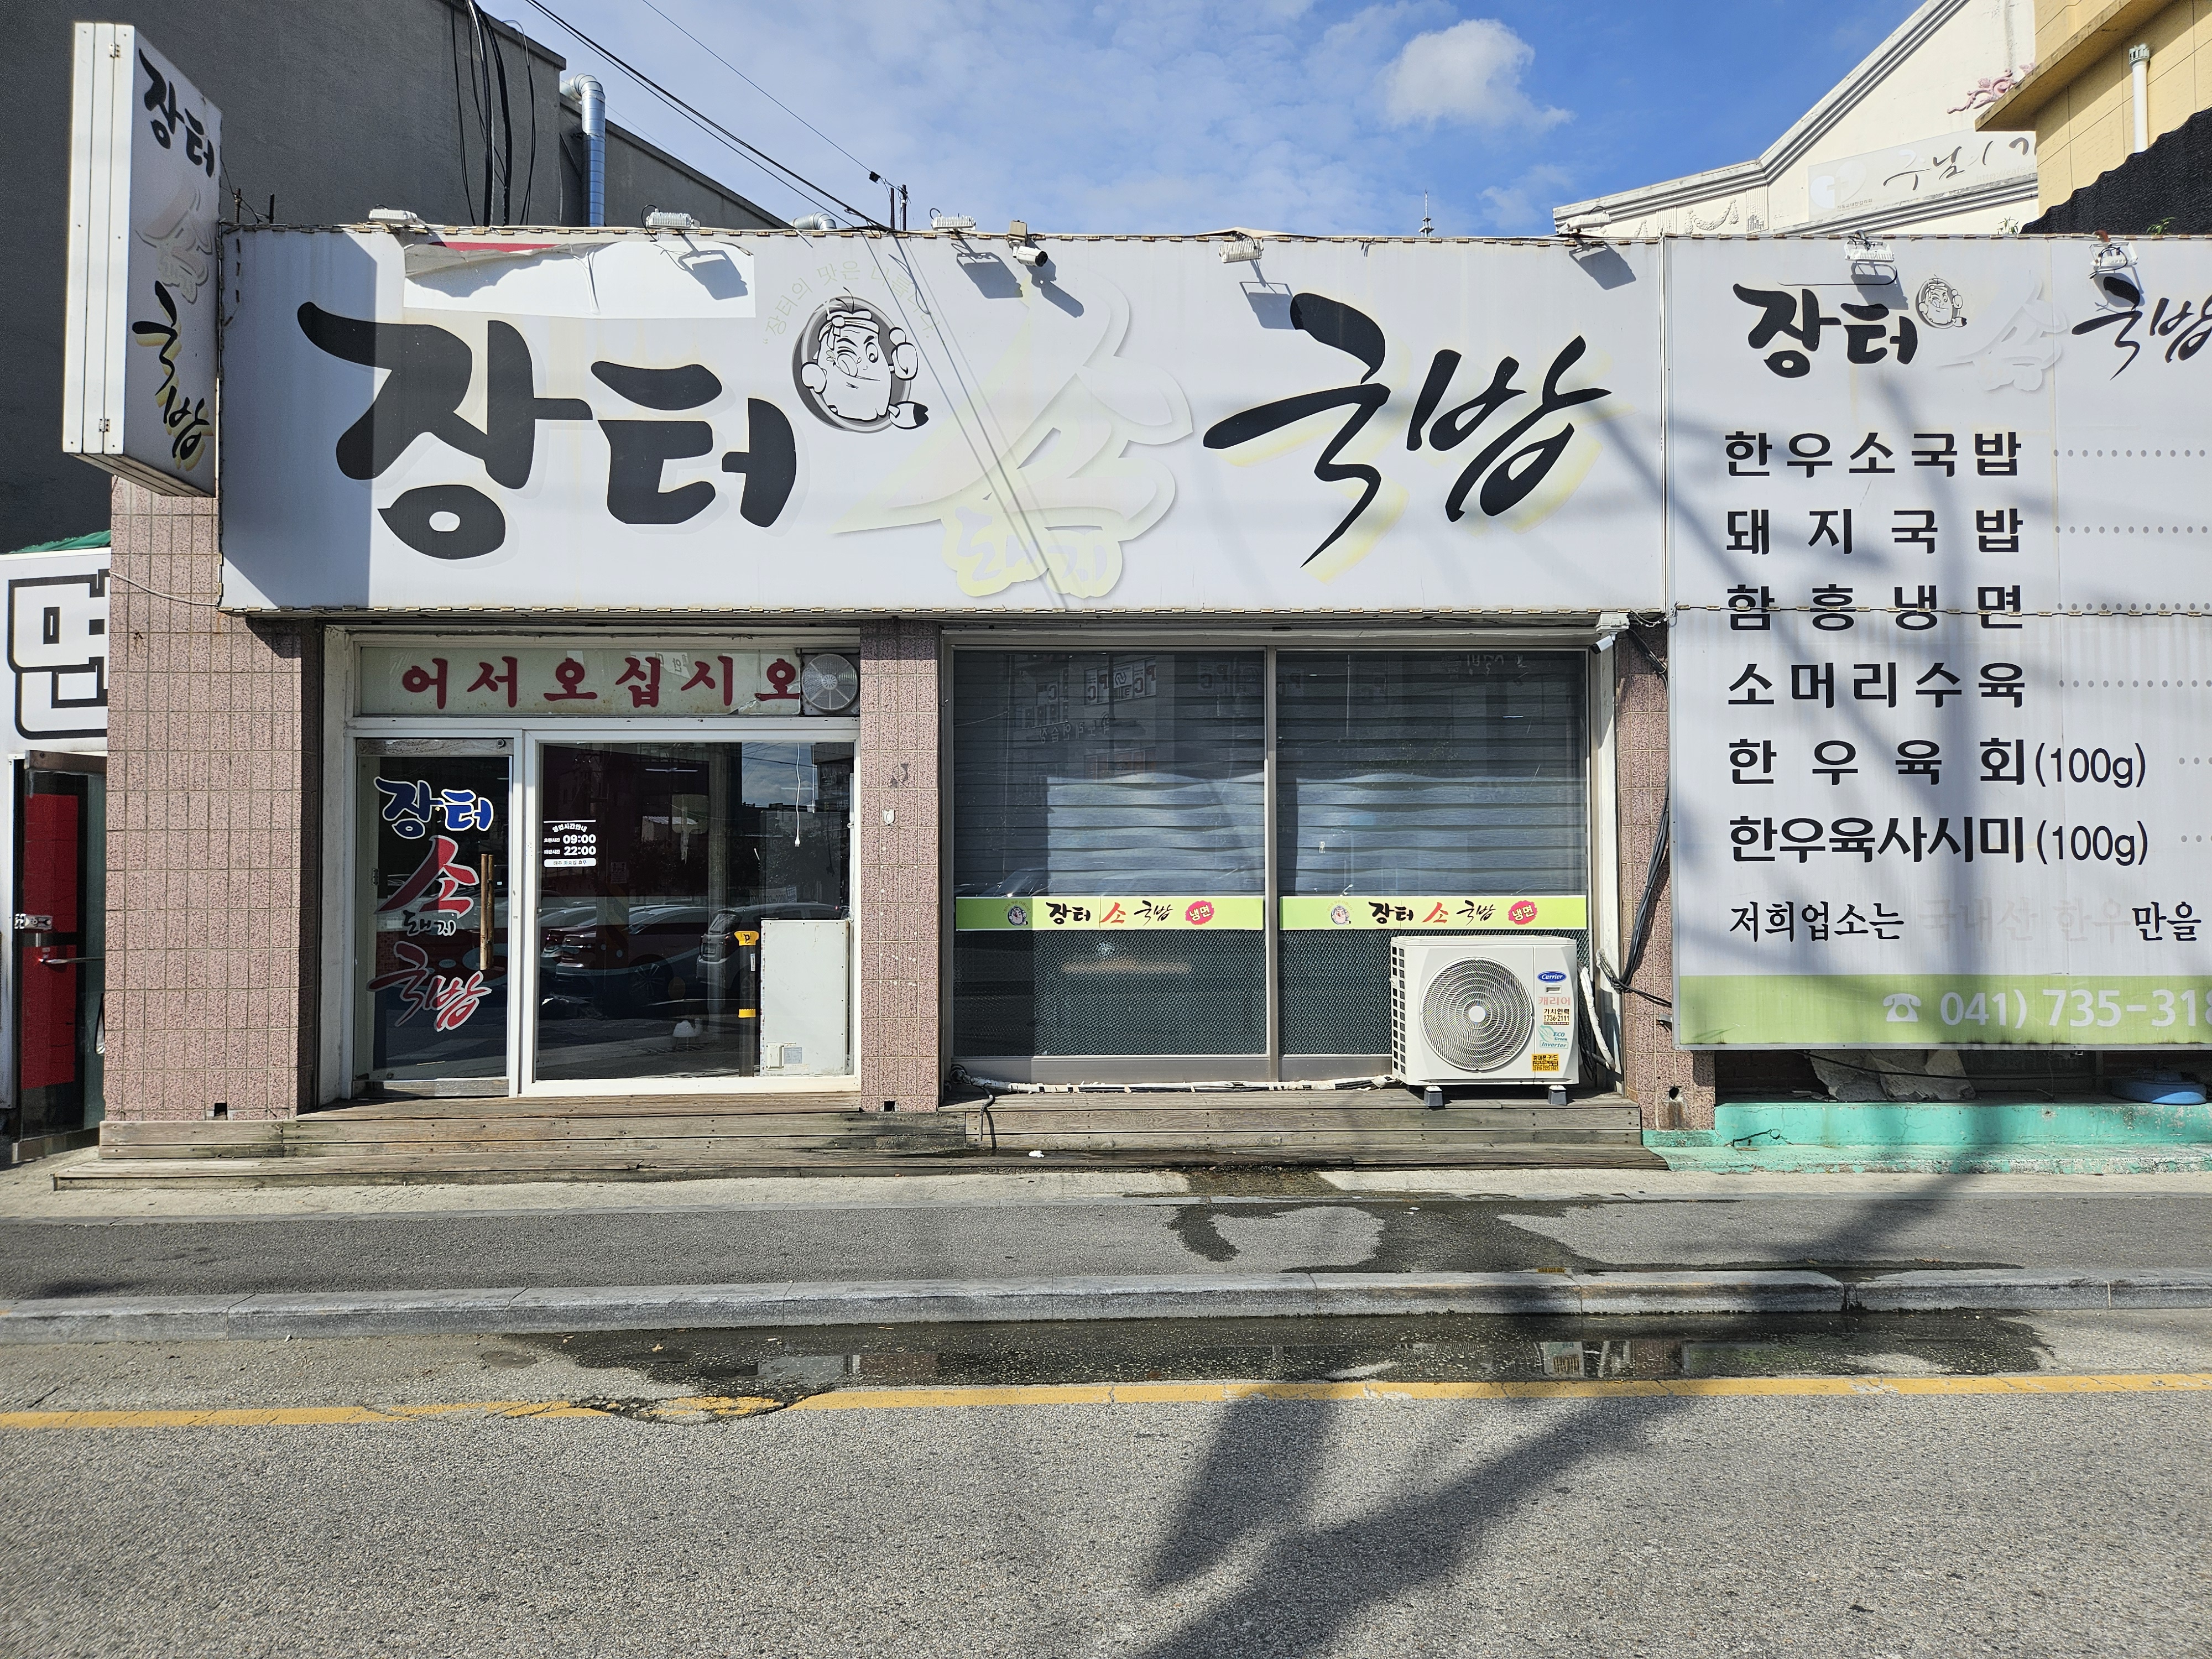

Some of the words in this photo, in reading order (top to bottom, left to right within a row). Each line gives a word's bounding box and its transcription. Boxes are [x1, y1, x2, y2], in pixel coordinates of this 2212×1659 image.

[138, 48, 215, 178] 장터
[1732, 283, 1919, 378] 장터
[2072, 276, 2212, 381] 국밥
[133, 280, 211, 460] 국밥
[297, 301, 797, 560] 장터
[1203, 293, 1613, 568] 국밥
[1725, 431, 2022, 477] 한우소국밥
[1728, 662, 2025, 708] 소머리수육
[374, 776, 494, 839] 장터
[562, 834, 597, 844] 09:00
[564, 846, 597, 856] 22:00
[373, 834, 480, 919] 소
[1045, 901, 1091, 925] 장터
[1099, 902, 1126, 924] 소
[1134, 900, 1173, 927] 국밥
[1188, 904, 1212, 921] 냉면
[1368, 901, 1414, 925] 장터
[1421, 902, 1449, 924] 소
[1455, 899, 1496, 926] 국밥
[1511, 904, 1535, 921] 냉면
[1729, 901, 1905, 942] 저희업소는
[366, 941, 492, 1032] 국밥
[1538, 997, 1571, 1006] 캐리어
[1940, 989, 2027, 1030] 041)
[2043, 989, 2212, 1028] 735-31
